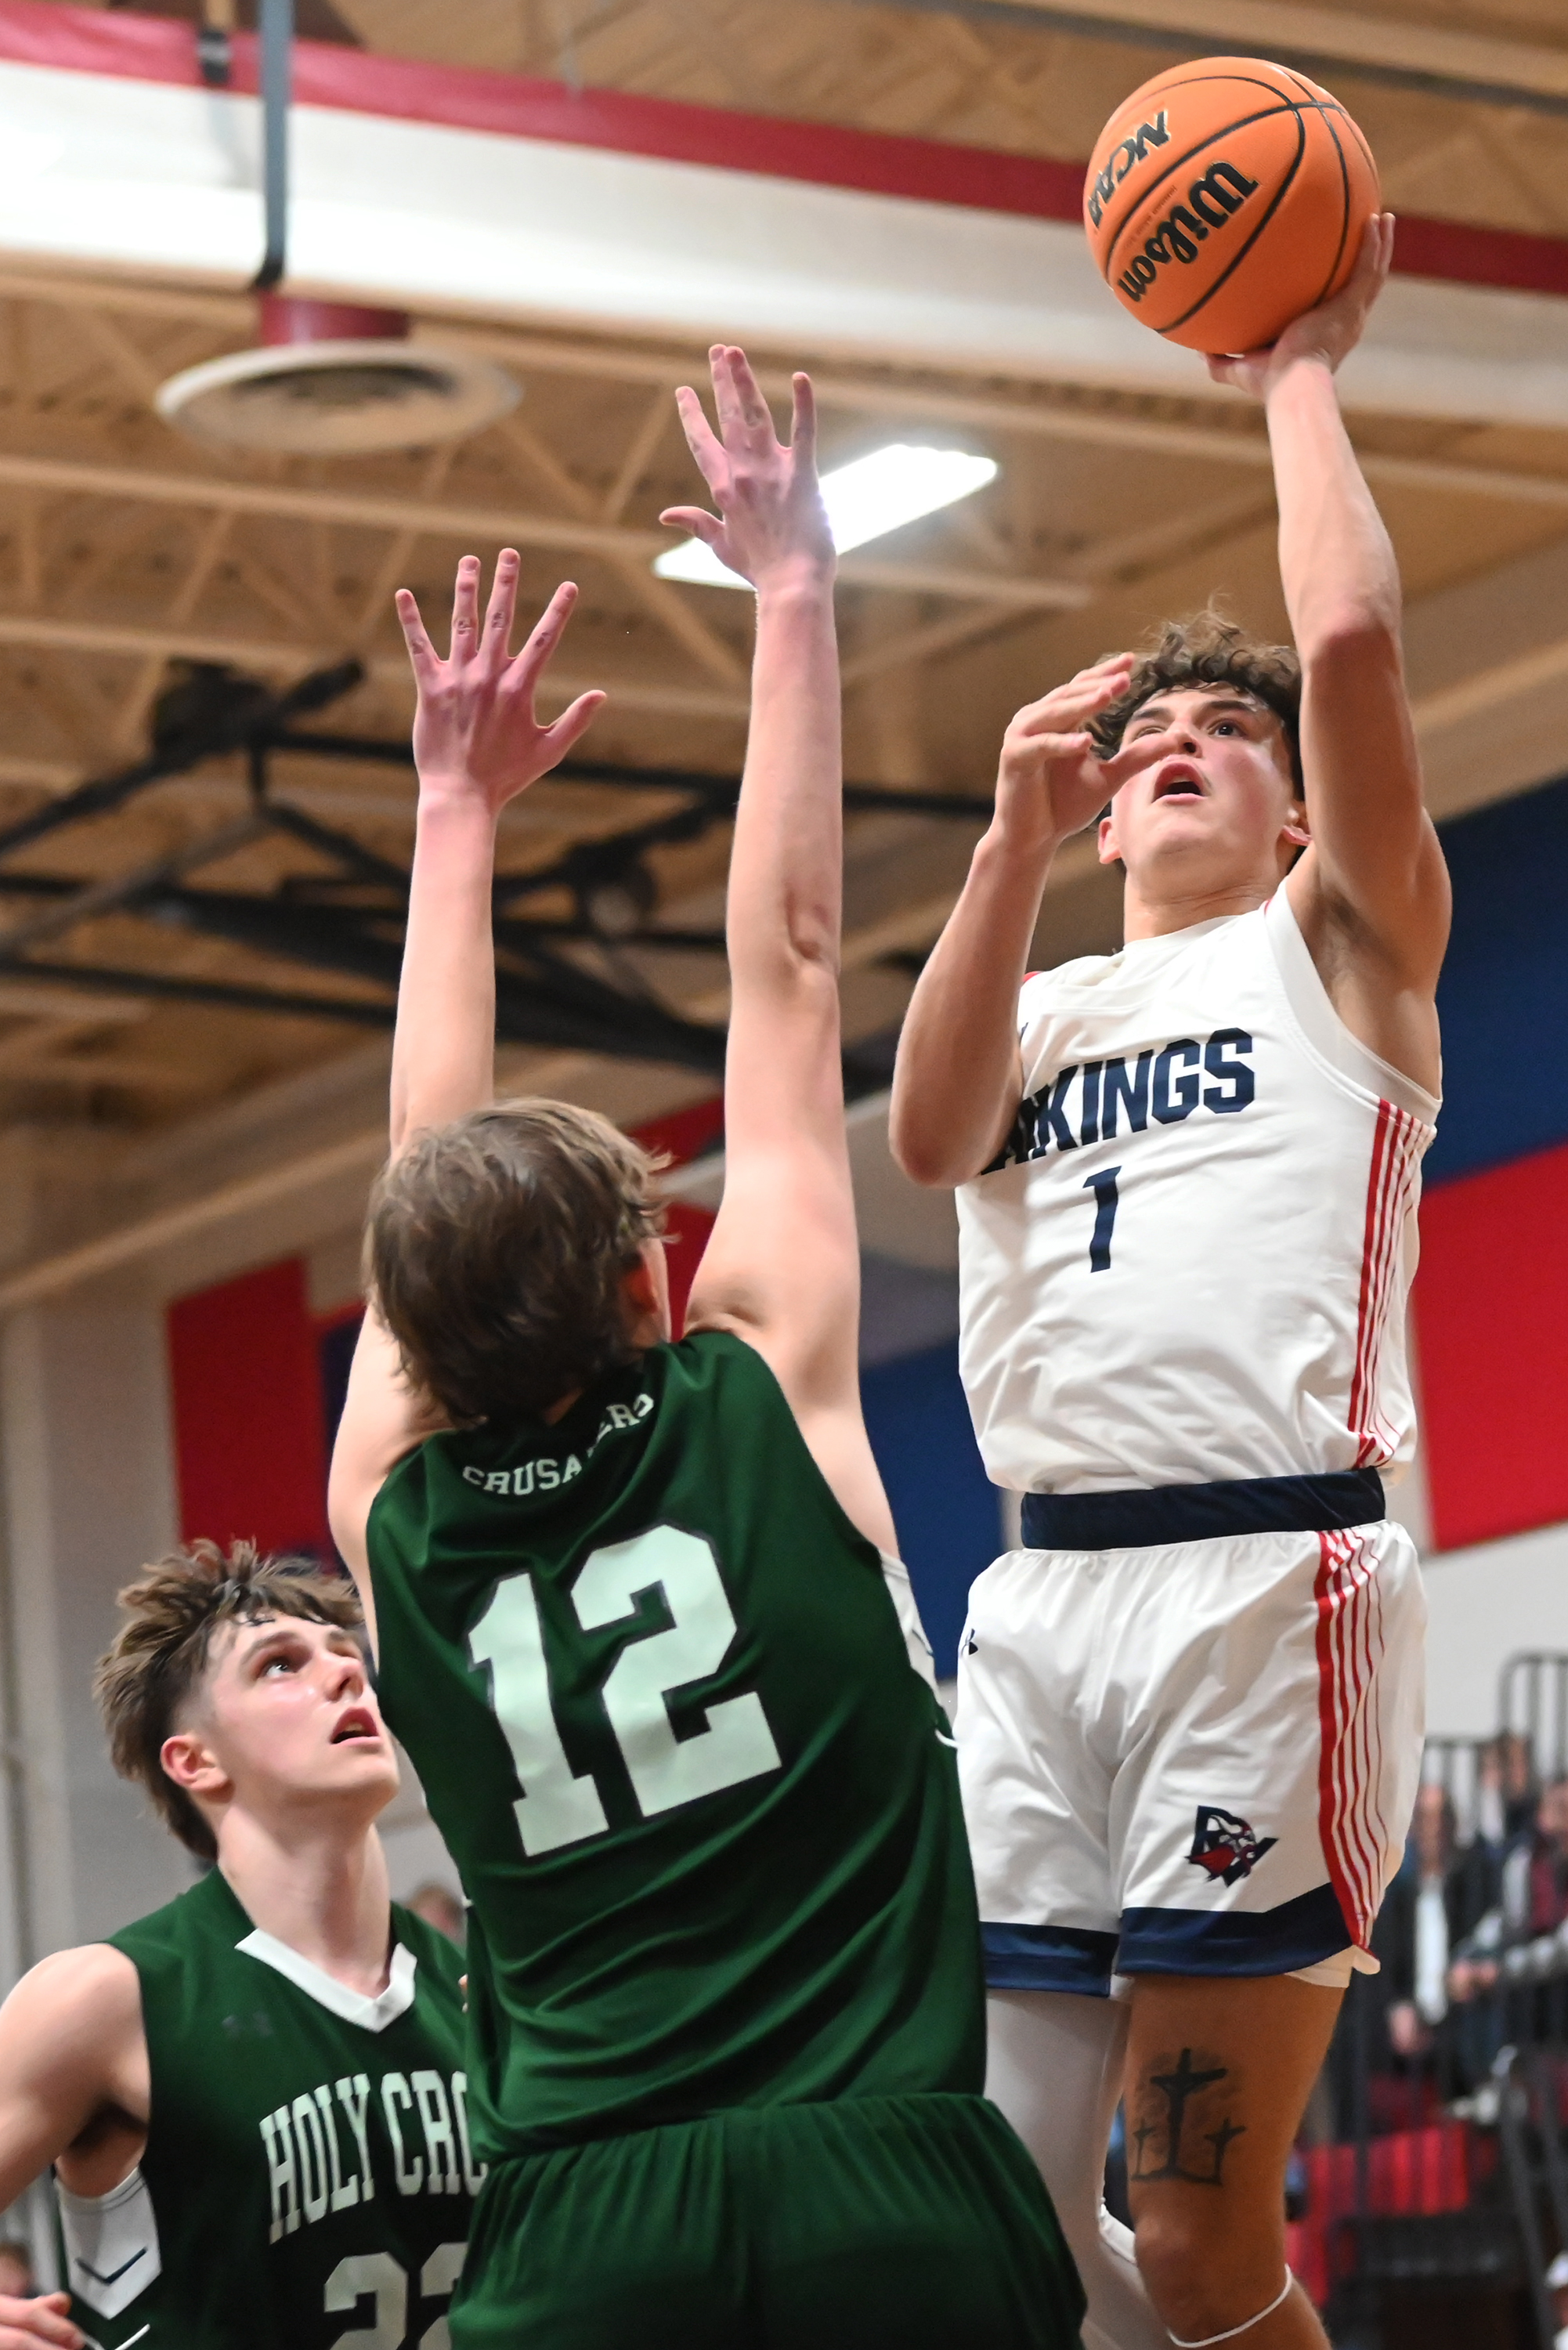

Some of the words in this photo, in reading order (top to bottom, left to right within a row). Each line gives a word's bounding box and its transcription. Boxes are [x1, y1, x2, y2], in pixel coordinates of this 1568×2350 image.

[1118, 161, 1259, 302] Wilson
[1082, 1166, 1122, 1273] 1
[462, 1394, 654, 1495] CRUSAR
[468, 1524, 782, 1856] 12
[259, 2073, 375, 2245] HOLY
